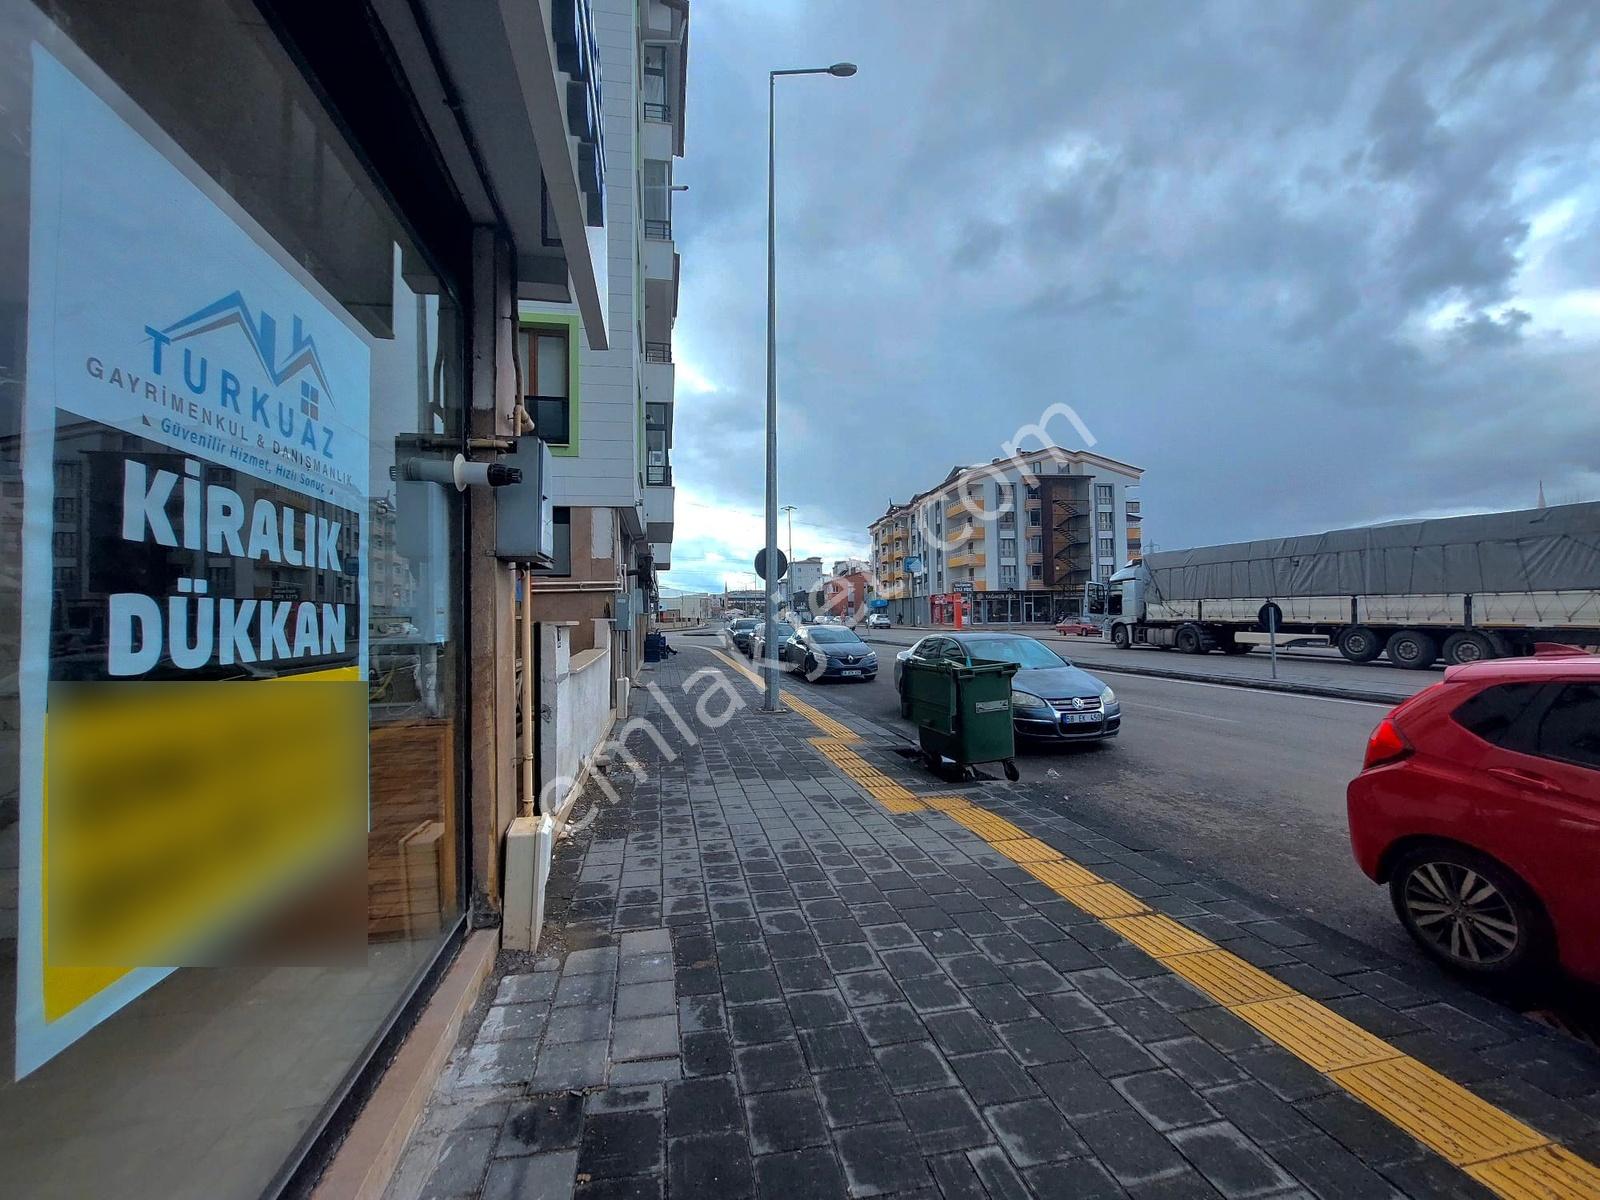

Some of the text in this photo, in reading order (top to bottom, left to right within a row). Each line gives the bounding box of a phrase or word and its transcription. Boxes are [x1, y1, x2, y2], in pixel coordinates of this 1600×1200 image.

[86, 357, 352, 486] GAYRİMENKUL & DANIŞMANLIK
[145, 325, 334, 459] TURKUAZ
[161, 417, 325, 493] Güvenilir Hizmet, Hızlı Sonuç
[122, 459, 342, 572] KİRALIK
[107, 578, 347, 677] DÜKKAN
